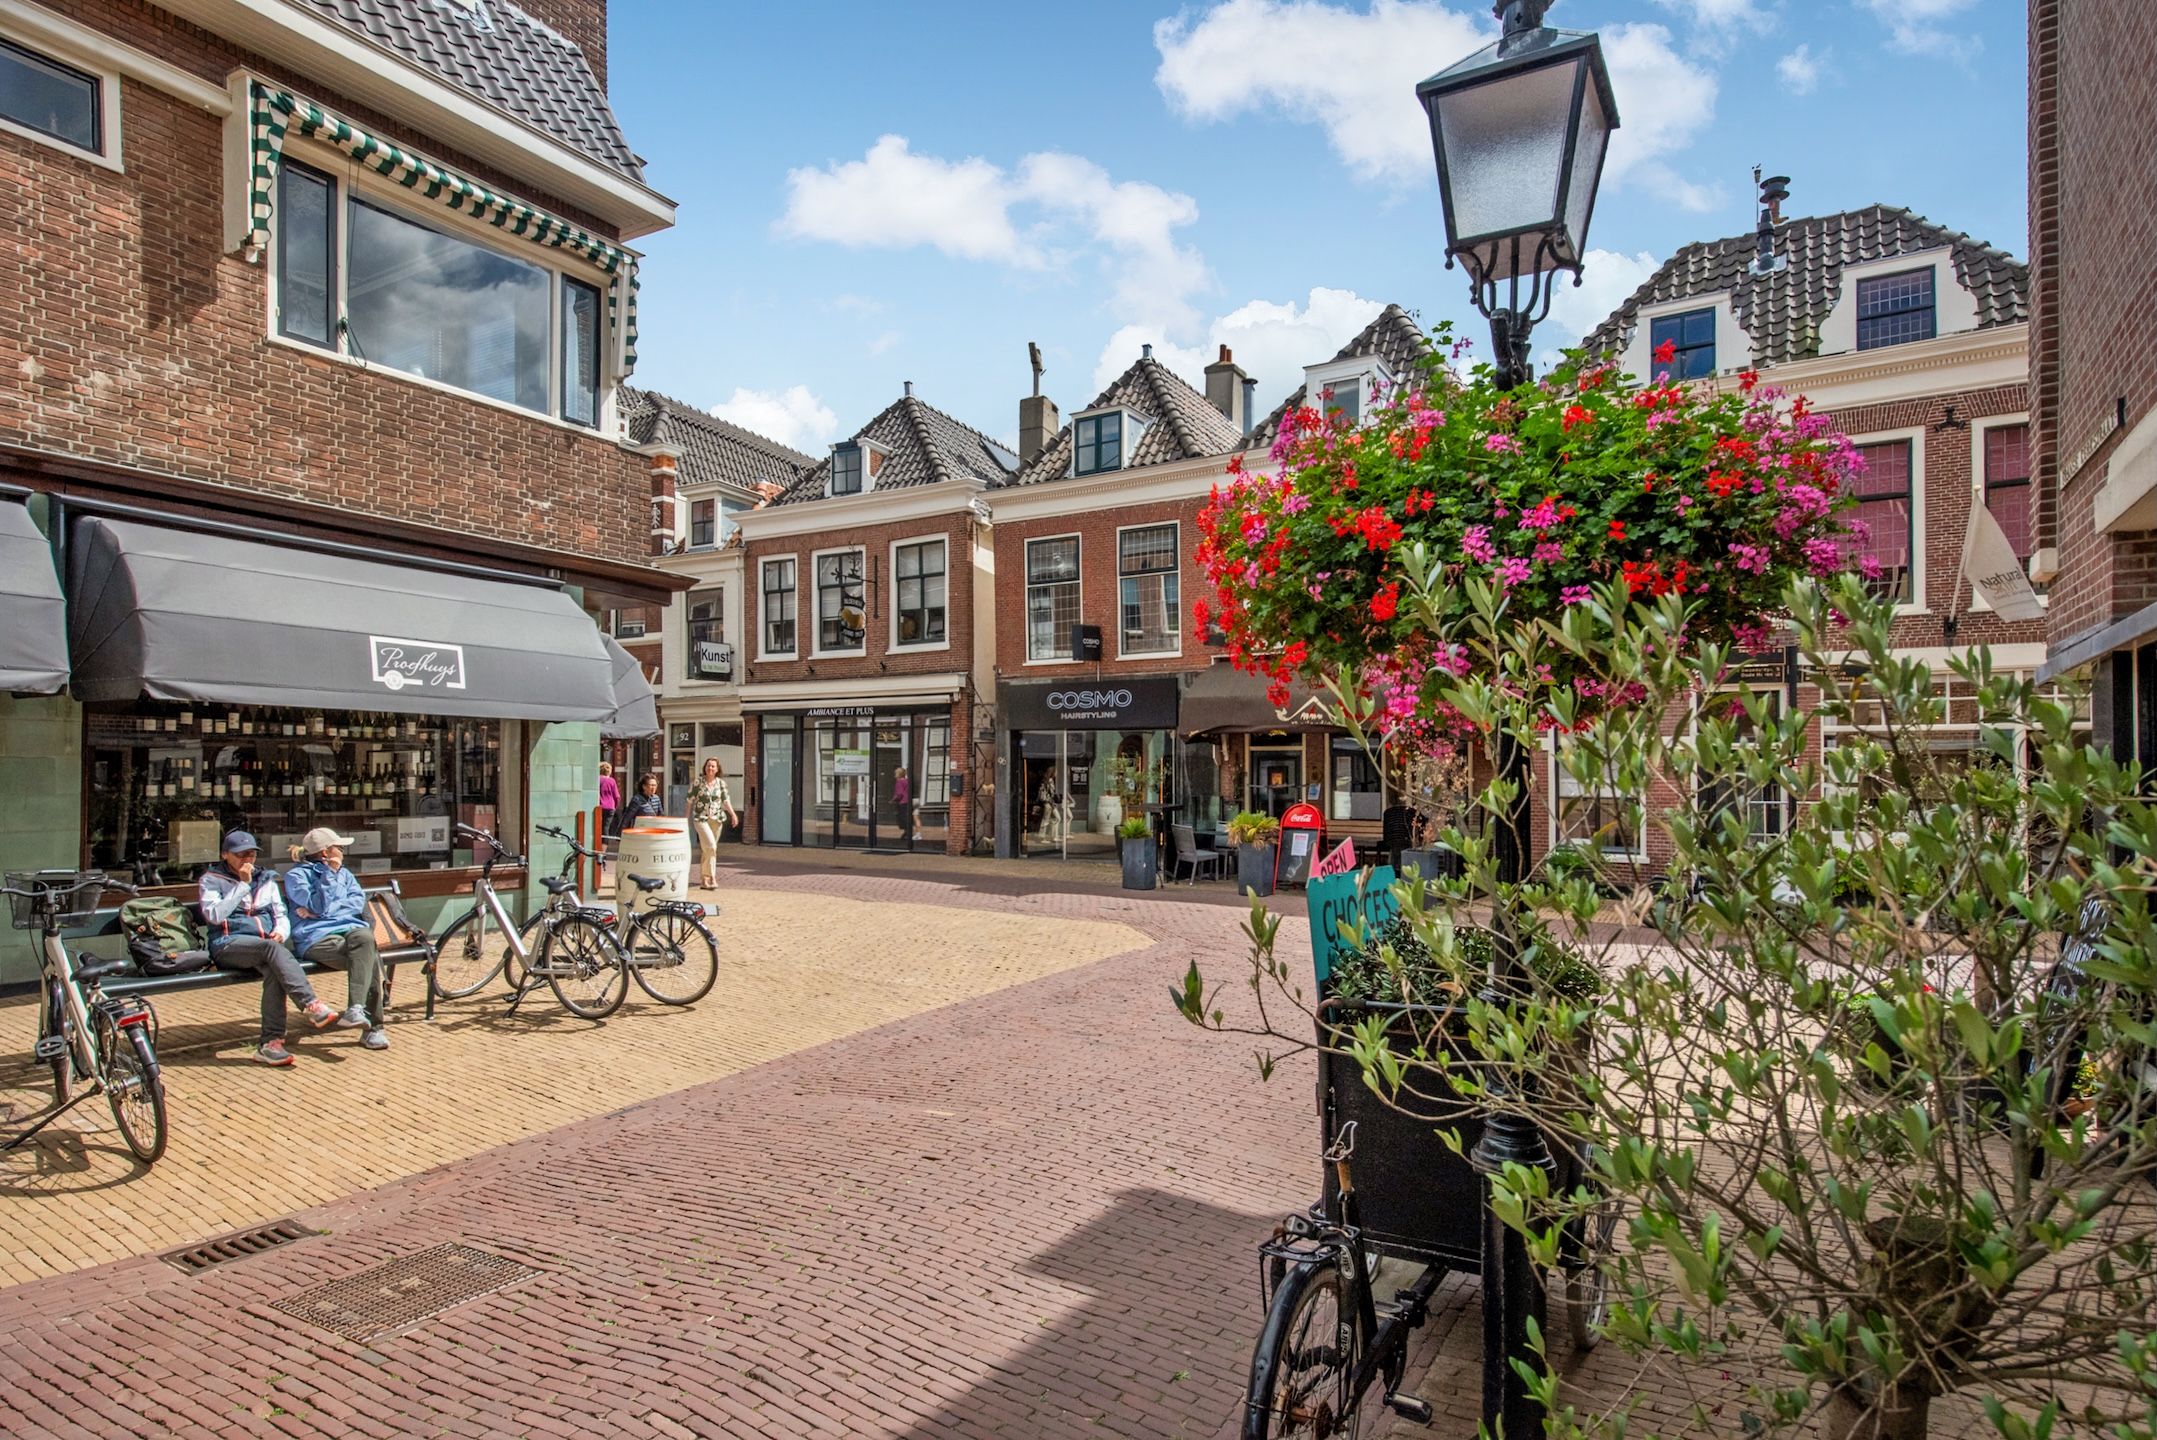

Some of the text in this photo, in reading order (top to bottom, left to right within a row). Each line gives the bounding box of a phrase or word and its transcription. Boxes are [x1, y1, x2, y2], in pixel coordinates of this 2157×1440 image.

[1980, 567, 2023, 589] Natural
[701, 648, 730, 663] Kunst
[380, 647, 456, 686] Proefhuys
[1046, 689, 1133, 710] COSMO
[807, 706, 875, 716] AMBIANCE ET PLUS
[1061, 711, 1117, 720] HAIRSTYLING
[680, 732, 689, 741] 92
[1320, 848, 1348, 879] OPEN
[1323, 888, 1392, 943] CHOCES
